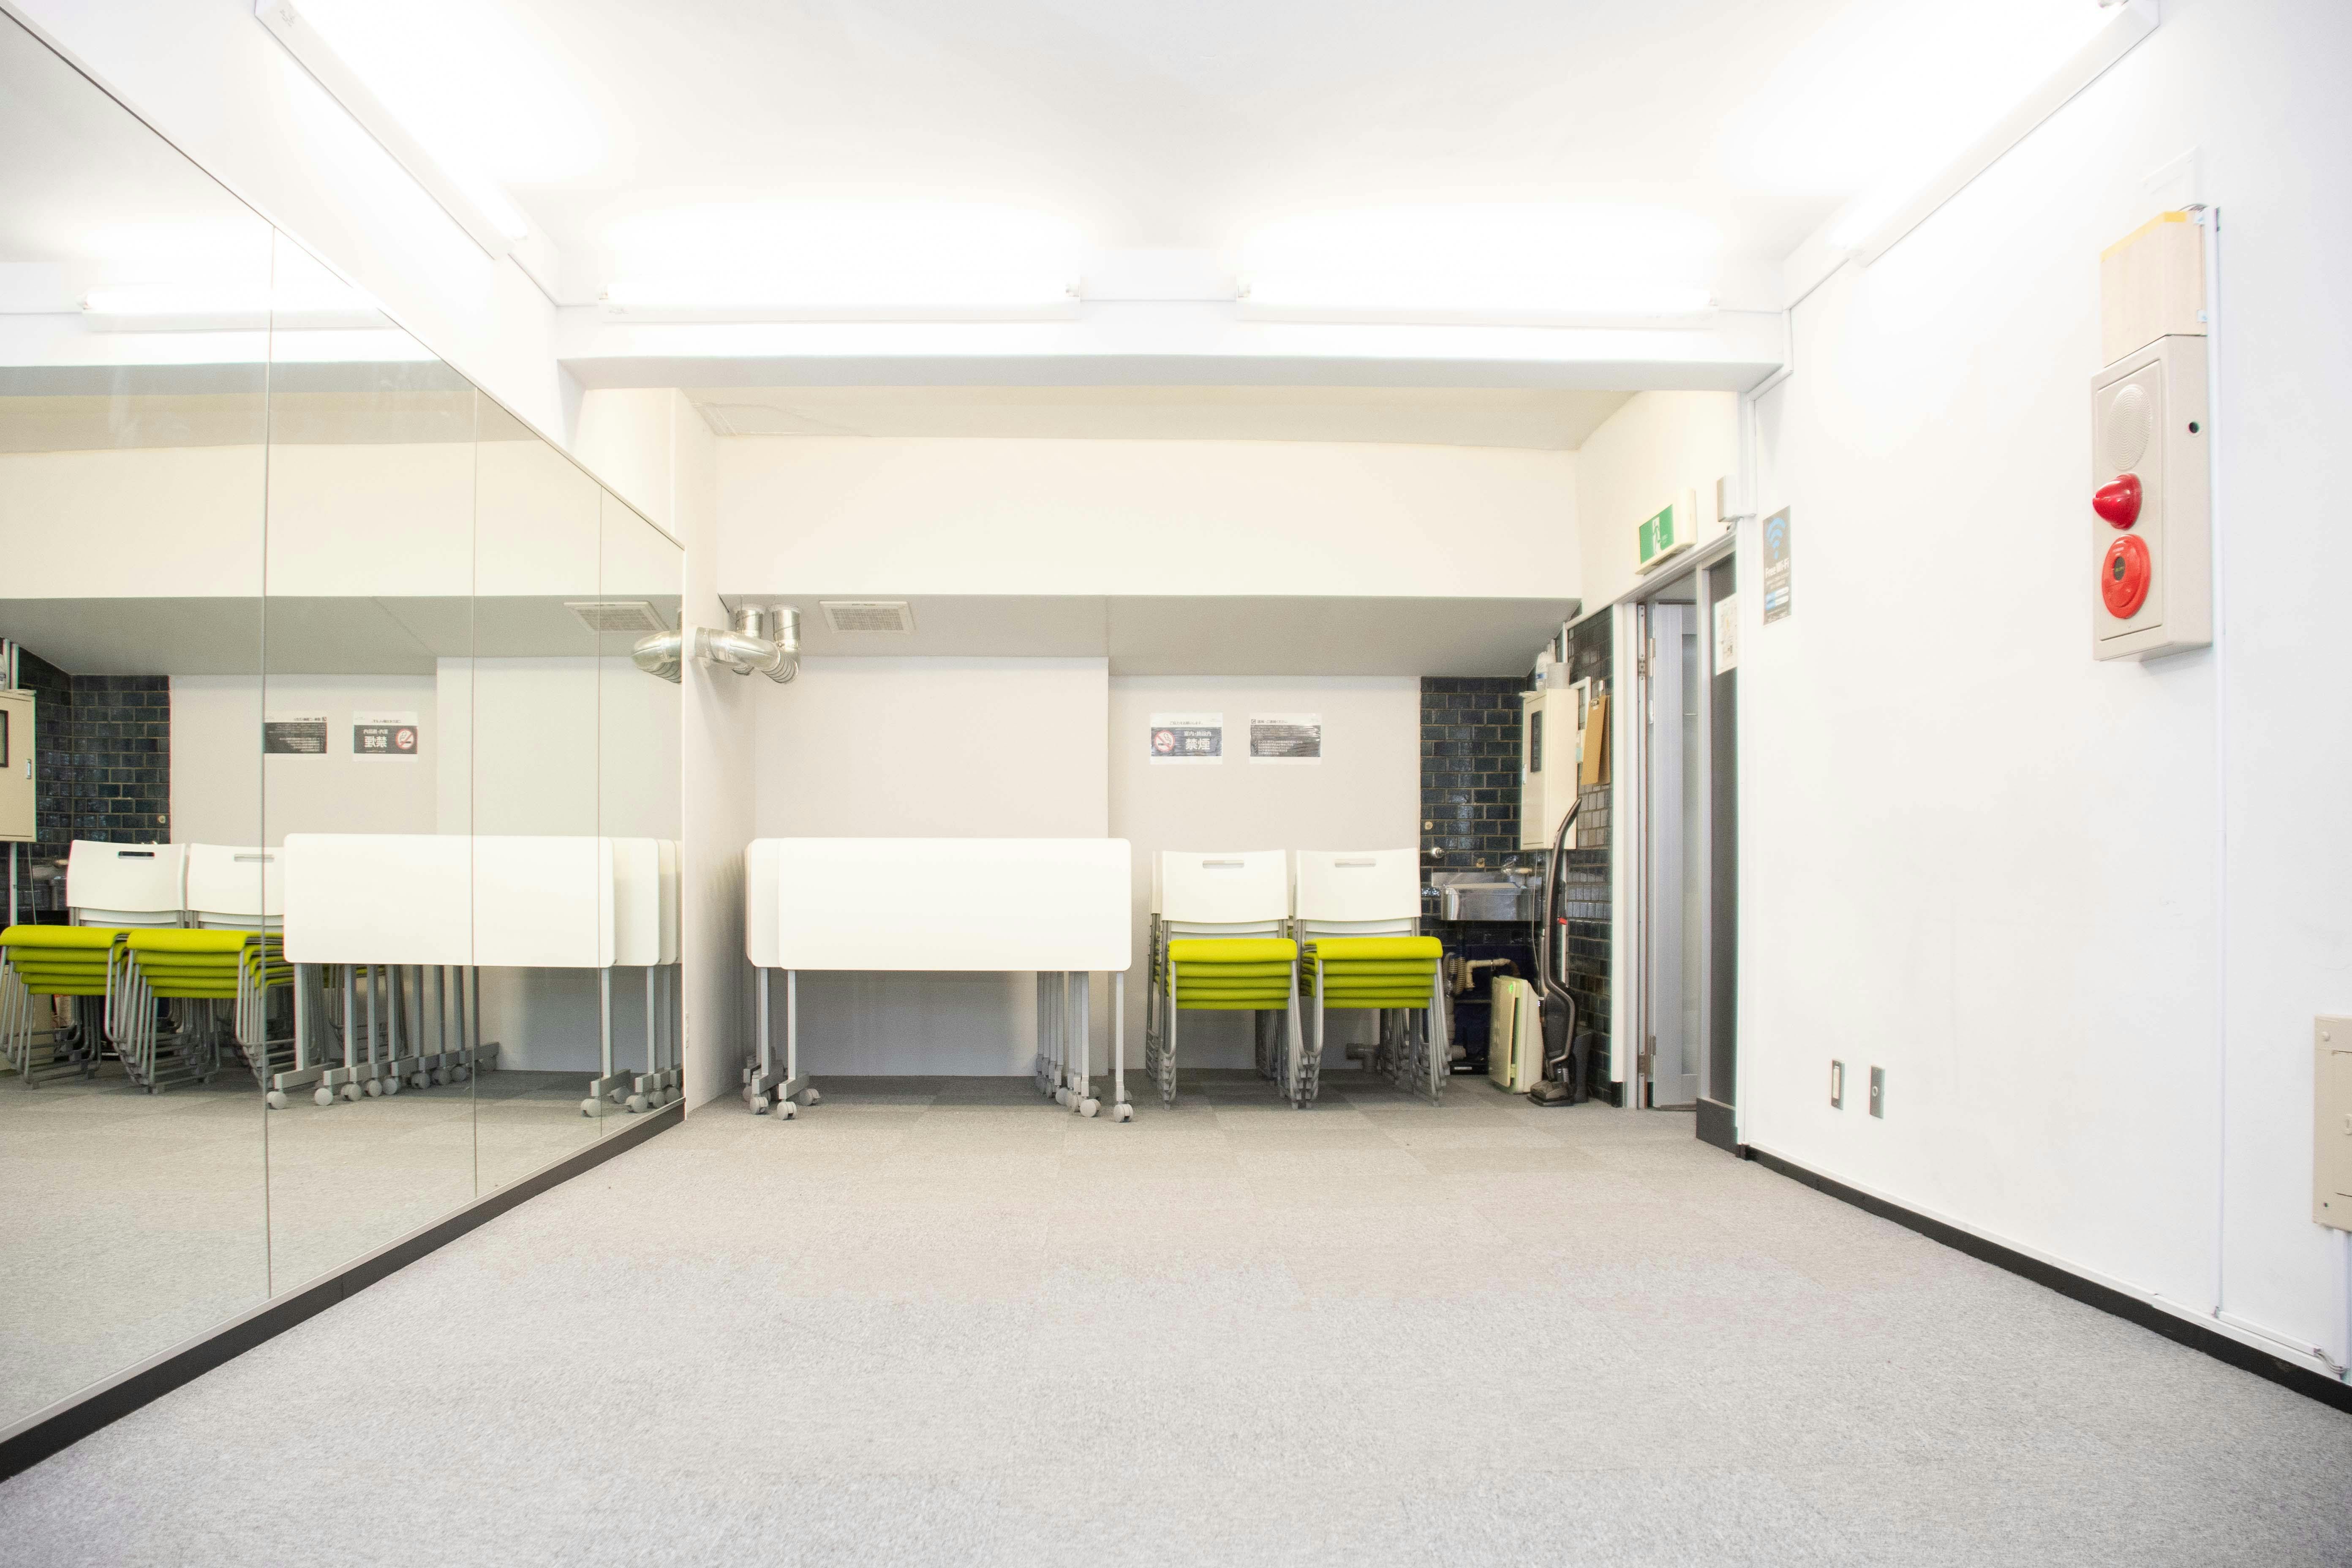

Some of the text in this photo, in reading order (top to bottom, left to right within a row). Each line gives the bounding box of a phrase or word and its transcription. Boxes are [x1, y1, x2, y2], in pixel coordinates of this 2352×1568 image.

[1765, 558, 1790, 579] Free Wi-Fi
[1185, 738, 1211, 750] 禁煙
